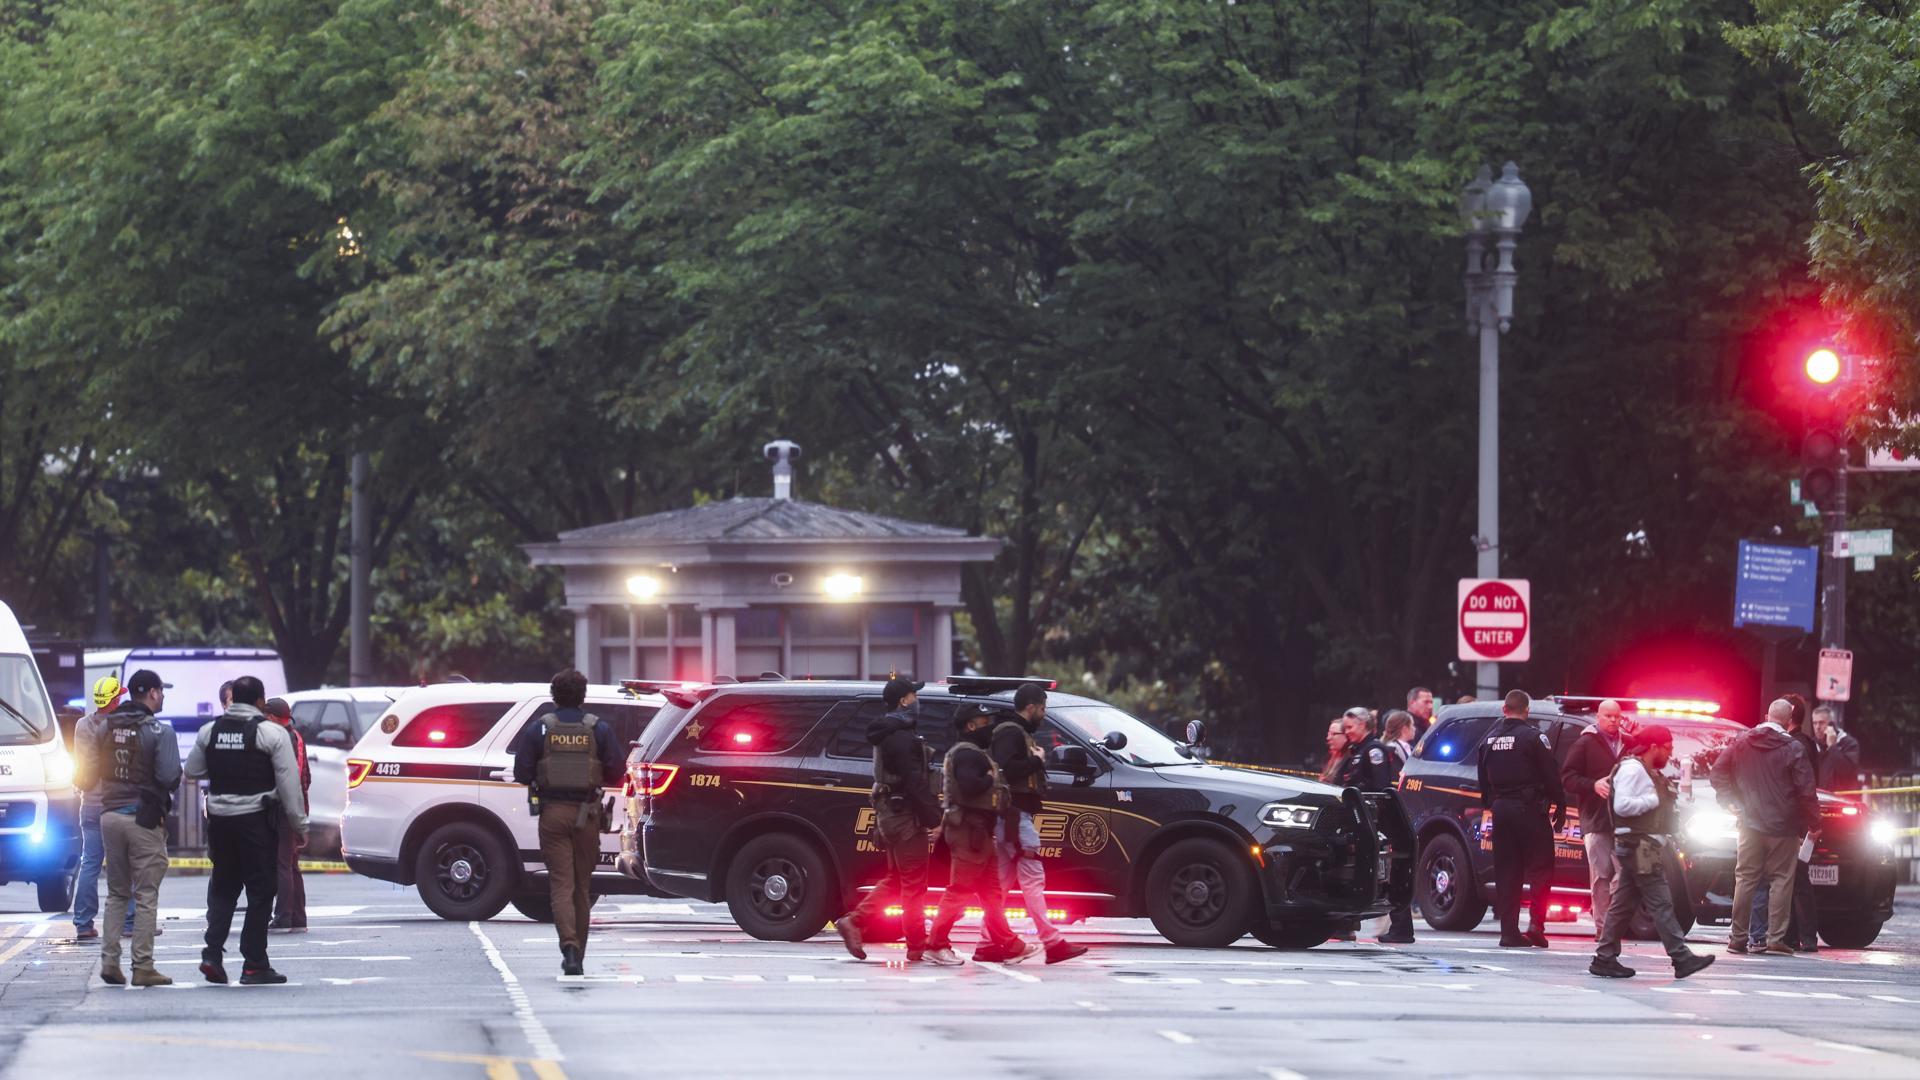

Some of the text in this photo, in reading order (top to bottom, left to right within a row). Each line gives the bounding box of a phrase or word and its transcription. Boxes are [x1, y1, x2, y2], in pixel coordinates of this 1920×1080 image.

[1470, 595, 1518, 609] DO NOT
[1474, 630, 1513, 644] ENTER
[217, 732, 244, 744] POLICE
[550, 735, 589, 745] POLICE
[1492, 743, 1514, 751] OLICE
[376, 763, 400, 776] 4413
[690, 774, 720, 787] 1874
[1406, 779, 1422, 791] 2981
